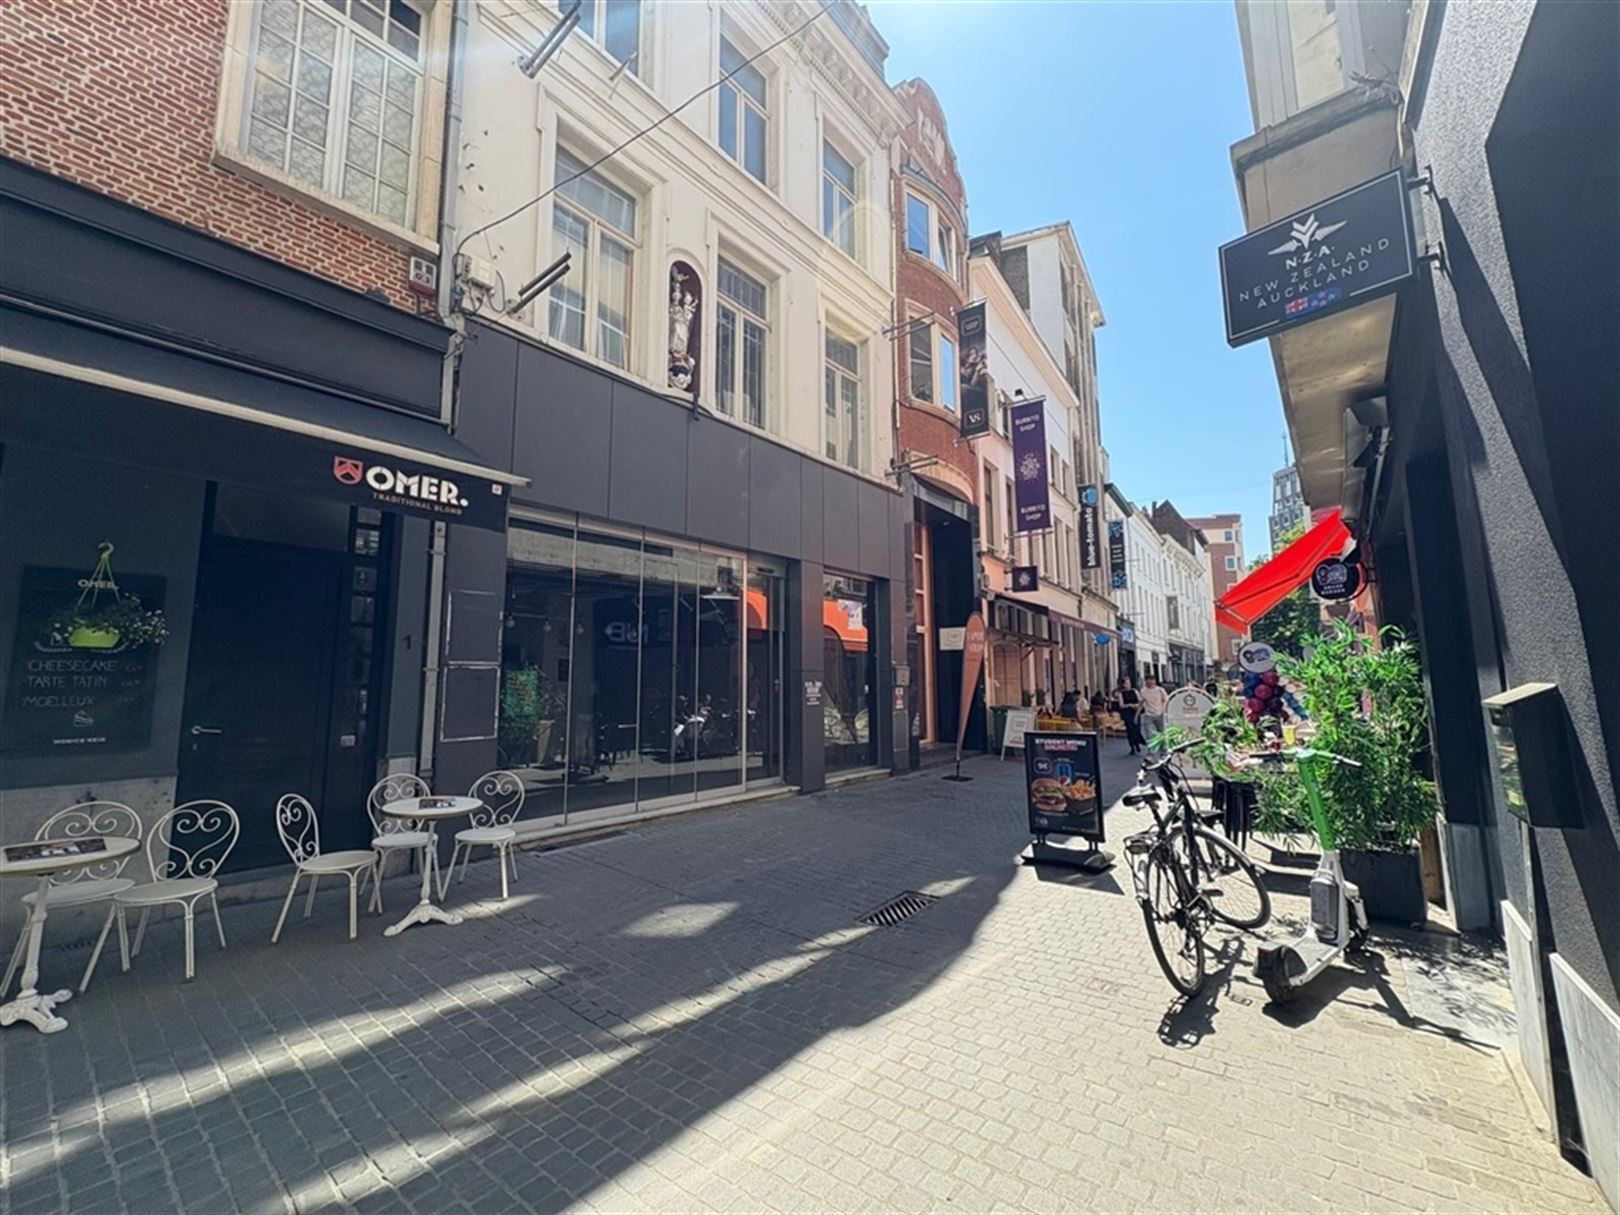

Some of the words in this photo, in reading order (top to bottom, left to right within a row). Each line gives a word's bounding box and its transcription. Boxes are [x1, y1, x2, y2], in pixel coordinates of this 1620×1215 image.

[1239, 279, 1279, 302] NEW
[1290, 237, 1390, 284] ZEALAND
[1257, 260, 1370, 310] AUCKLAND
[1015, 414, 1040, 426] BURRITO
[1020, 422, 1036, 432] SHOP
[365, 465, 469, 508] OMER.
[373, 491, 432, 511] TRADITIONAL
[434, 501, 463, 516] BLOND
[1021, 503, 1046, 514] BURRITO
[1025, 512, 1042, 521] SHOP
[27, 660, 118, 672] CHEESECAKE
[27, 676, 66, 688] TARTE
[72, 676, 108, 688] TATIN
[22, 696, 96, 708] MOELLEUX
